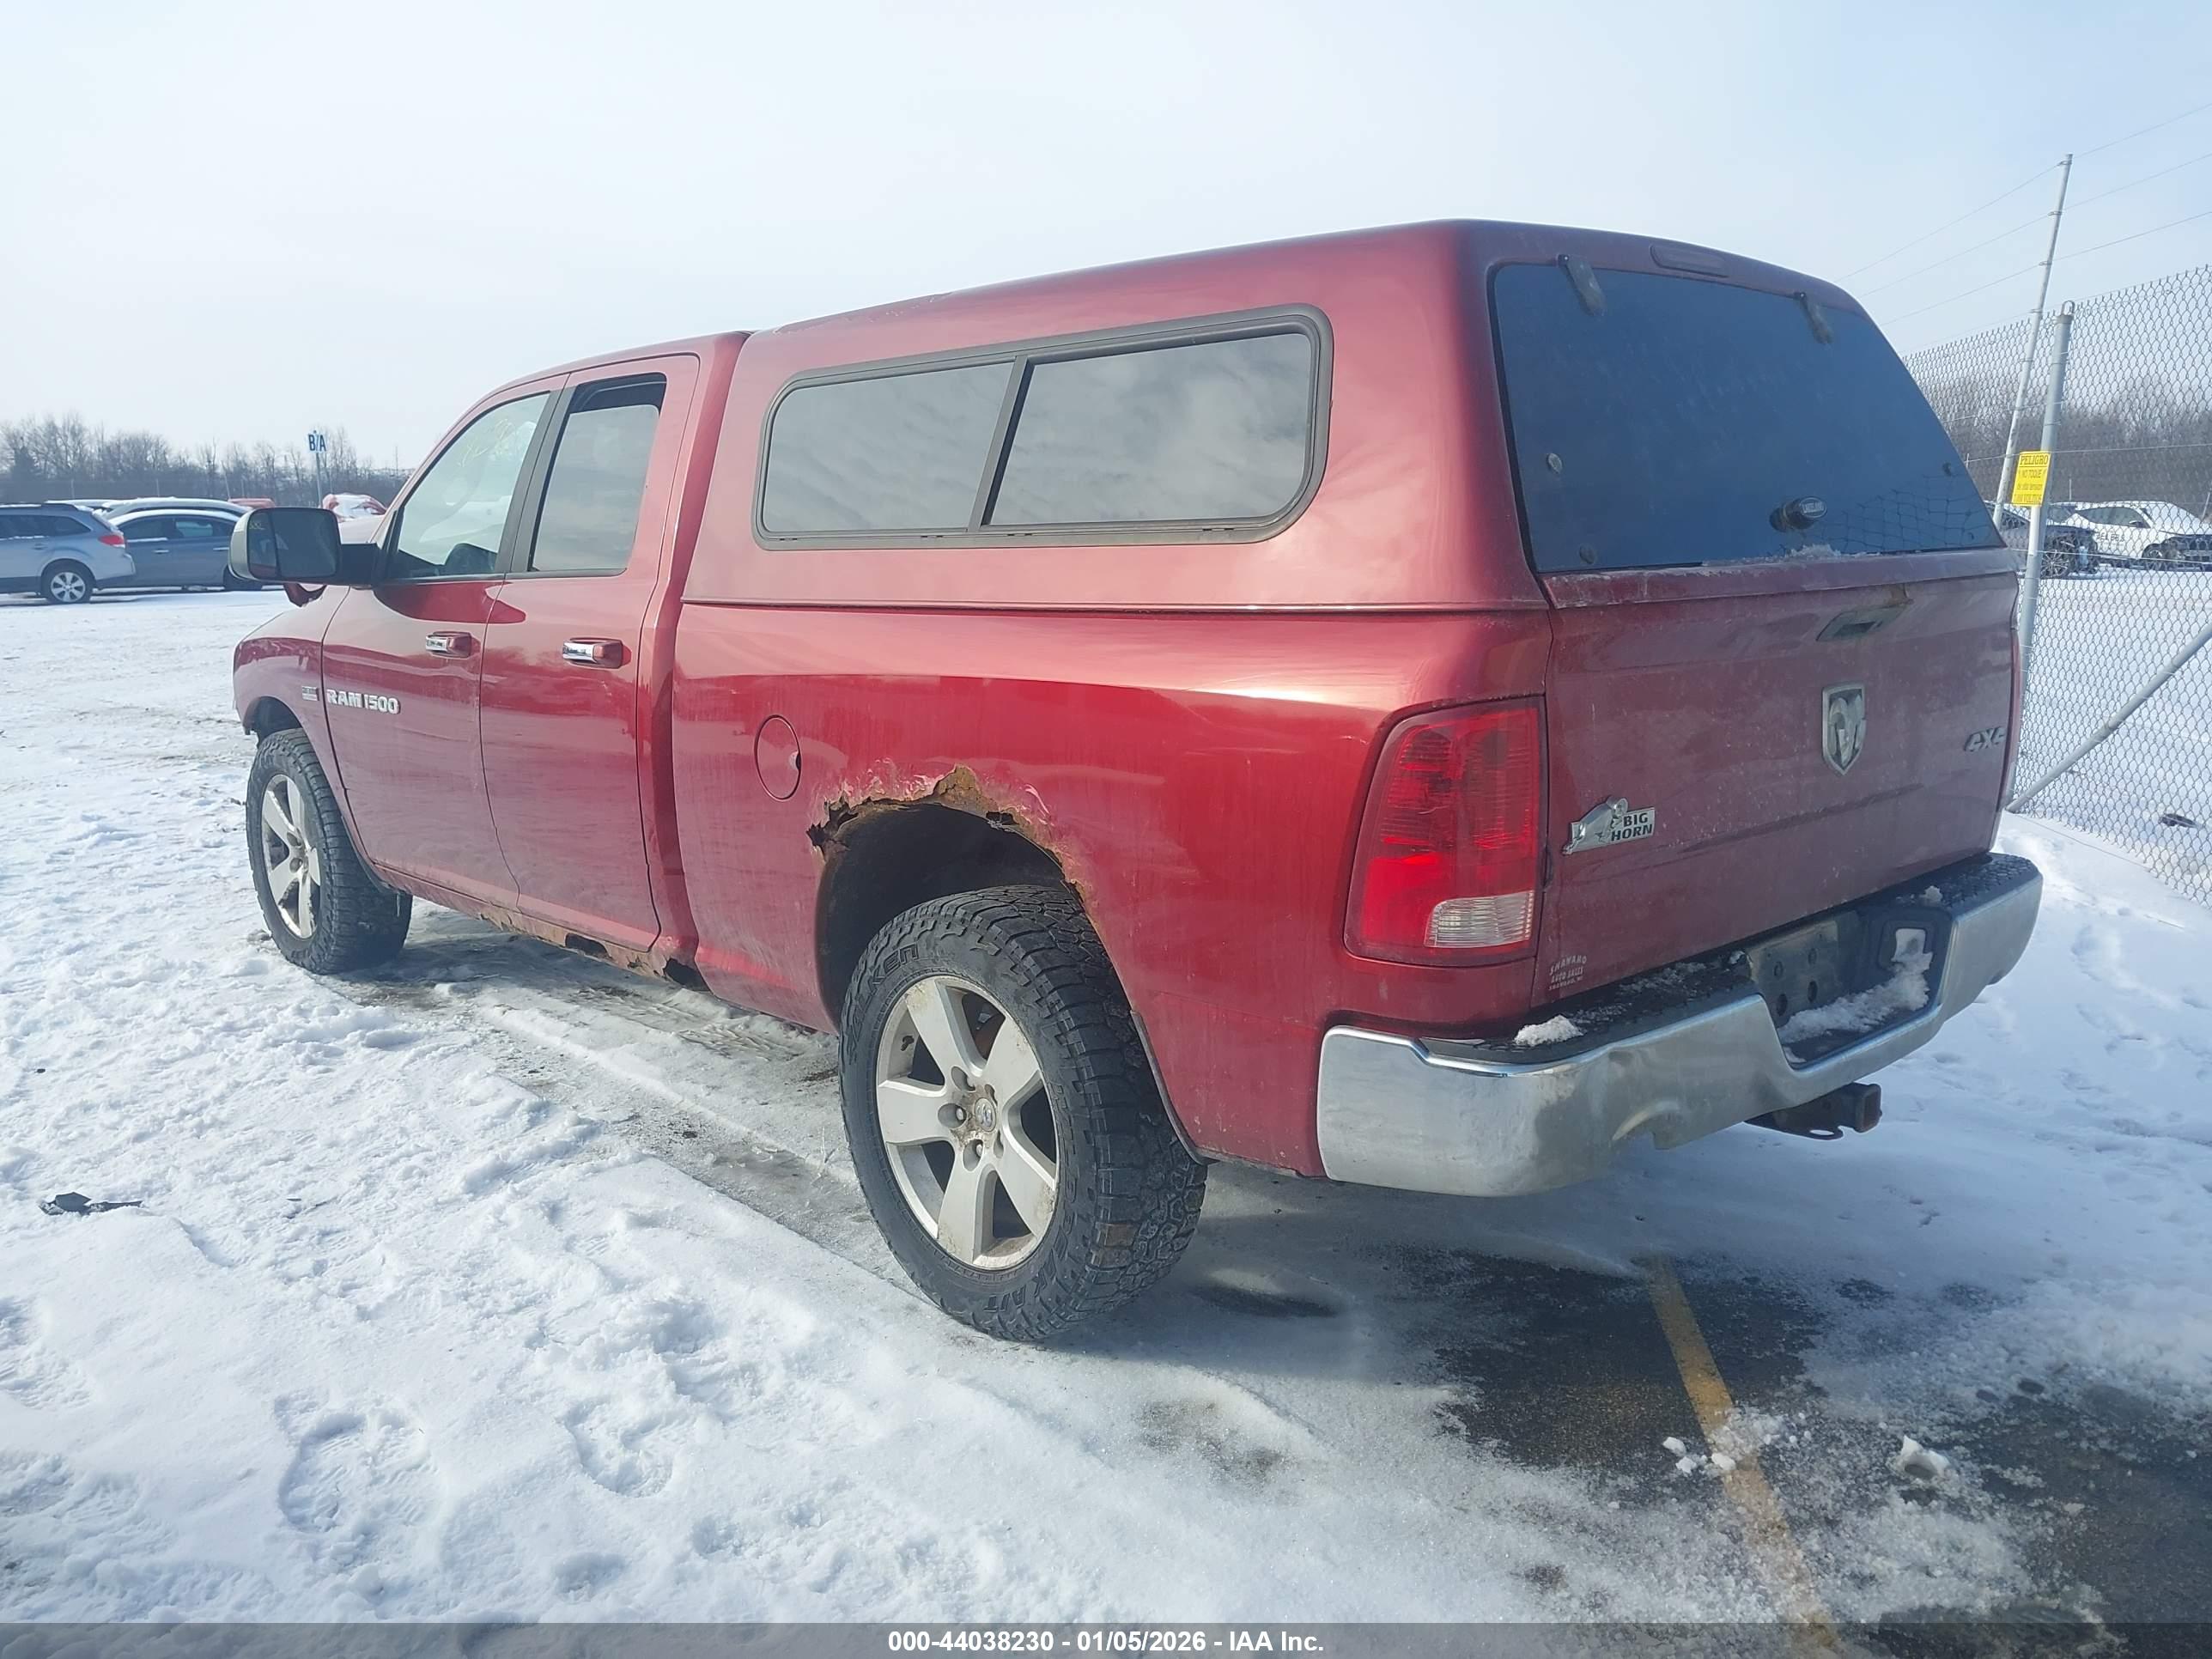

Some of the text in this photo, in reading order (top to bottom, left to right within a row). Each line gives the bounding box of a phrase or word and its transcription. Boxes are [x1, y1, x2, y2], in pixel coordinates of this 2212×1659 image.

[2020, 455, 2049, 465] PELIGRO
[326, 689, 364, 708] RAM
[363, 694, 401, 714] 1500
[1623, 812, 1649, 827] BIG
[1611, 823, 1653, 842] HORN
